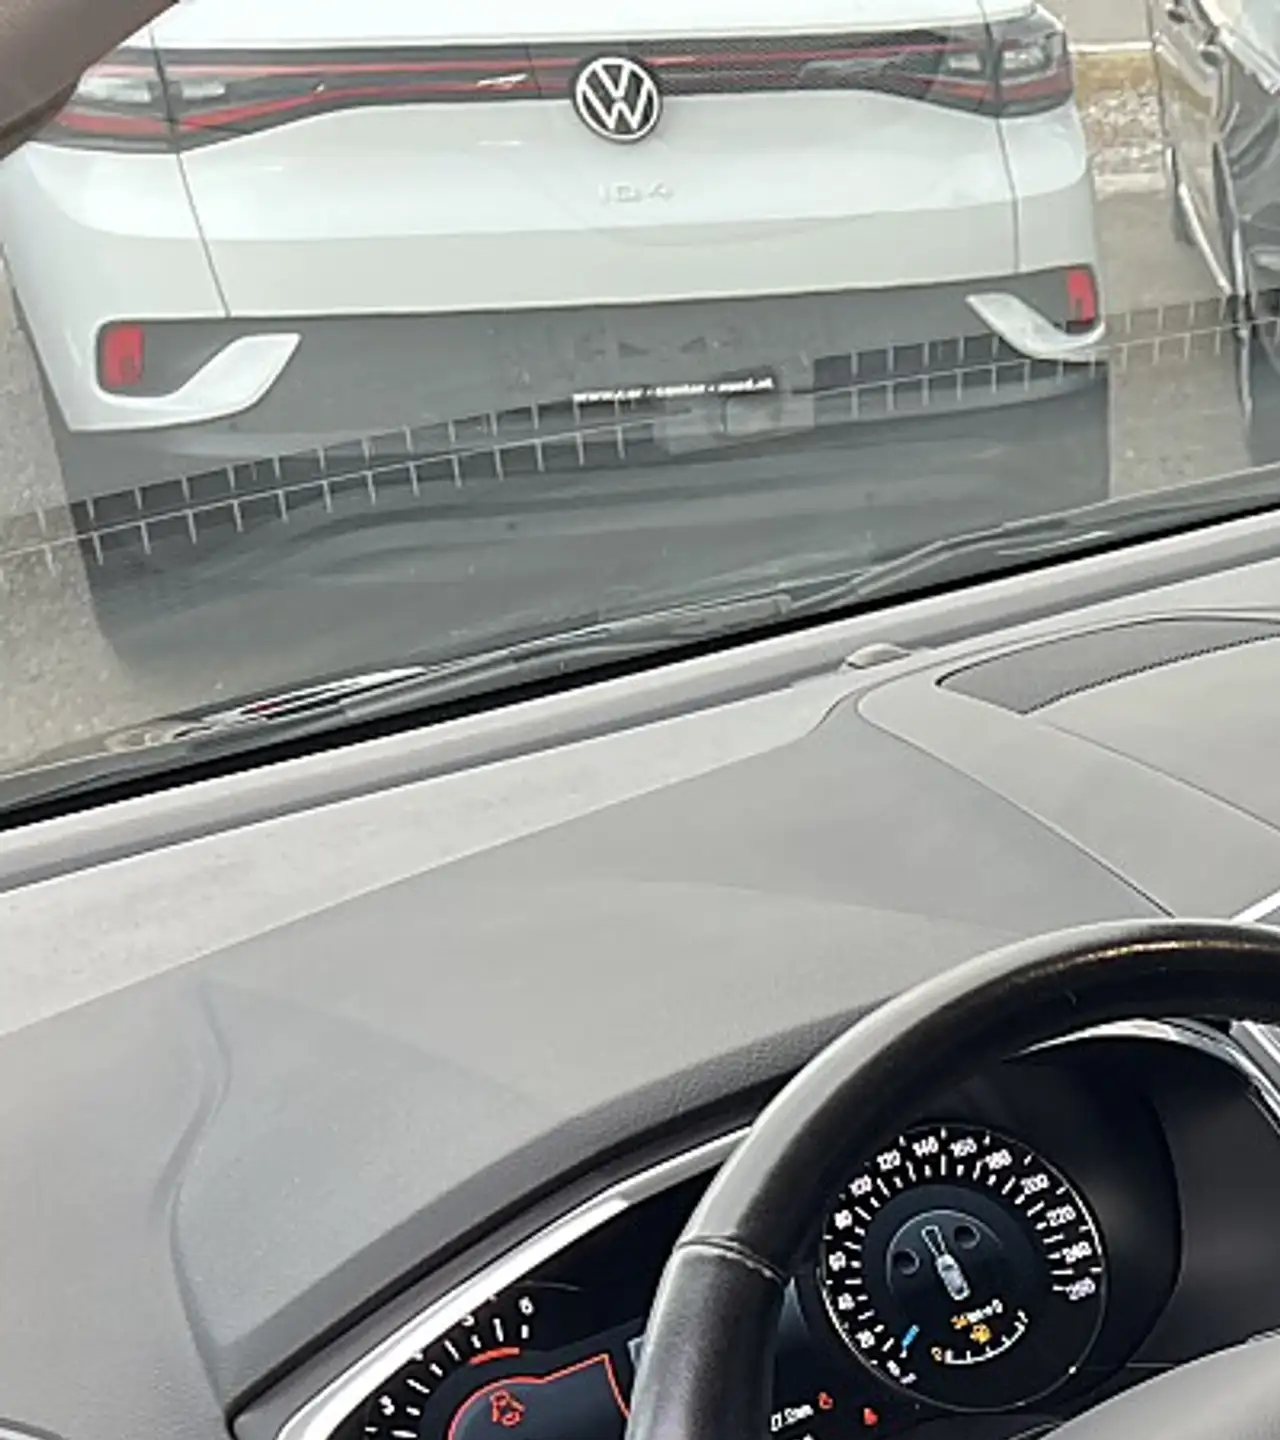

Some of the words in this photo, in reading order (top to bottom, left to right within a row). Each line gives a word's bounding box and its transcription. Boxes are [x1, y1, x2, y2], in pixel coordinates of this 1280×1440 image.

[912, 1136, 939, 1157] 140
[950, 1137, 977, 1158] 160
[876, 1149, 901, 1172] 120
[985, 1149, 1013, 1170] 180
[848, 1174, 872, 1198] 100
[1020, 1173, 1049, 1195] 200
[1046, 1203, 1076, 1227] 220
[379, 1395, 396, 1416] 3
